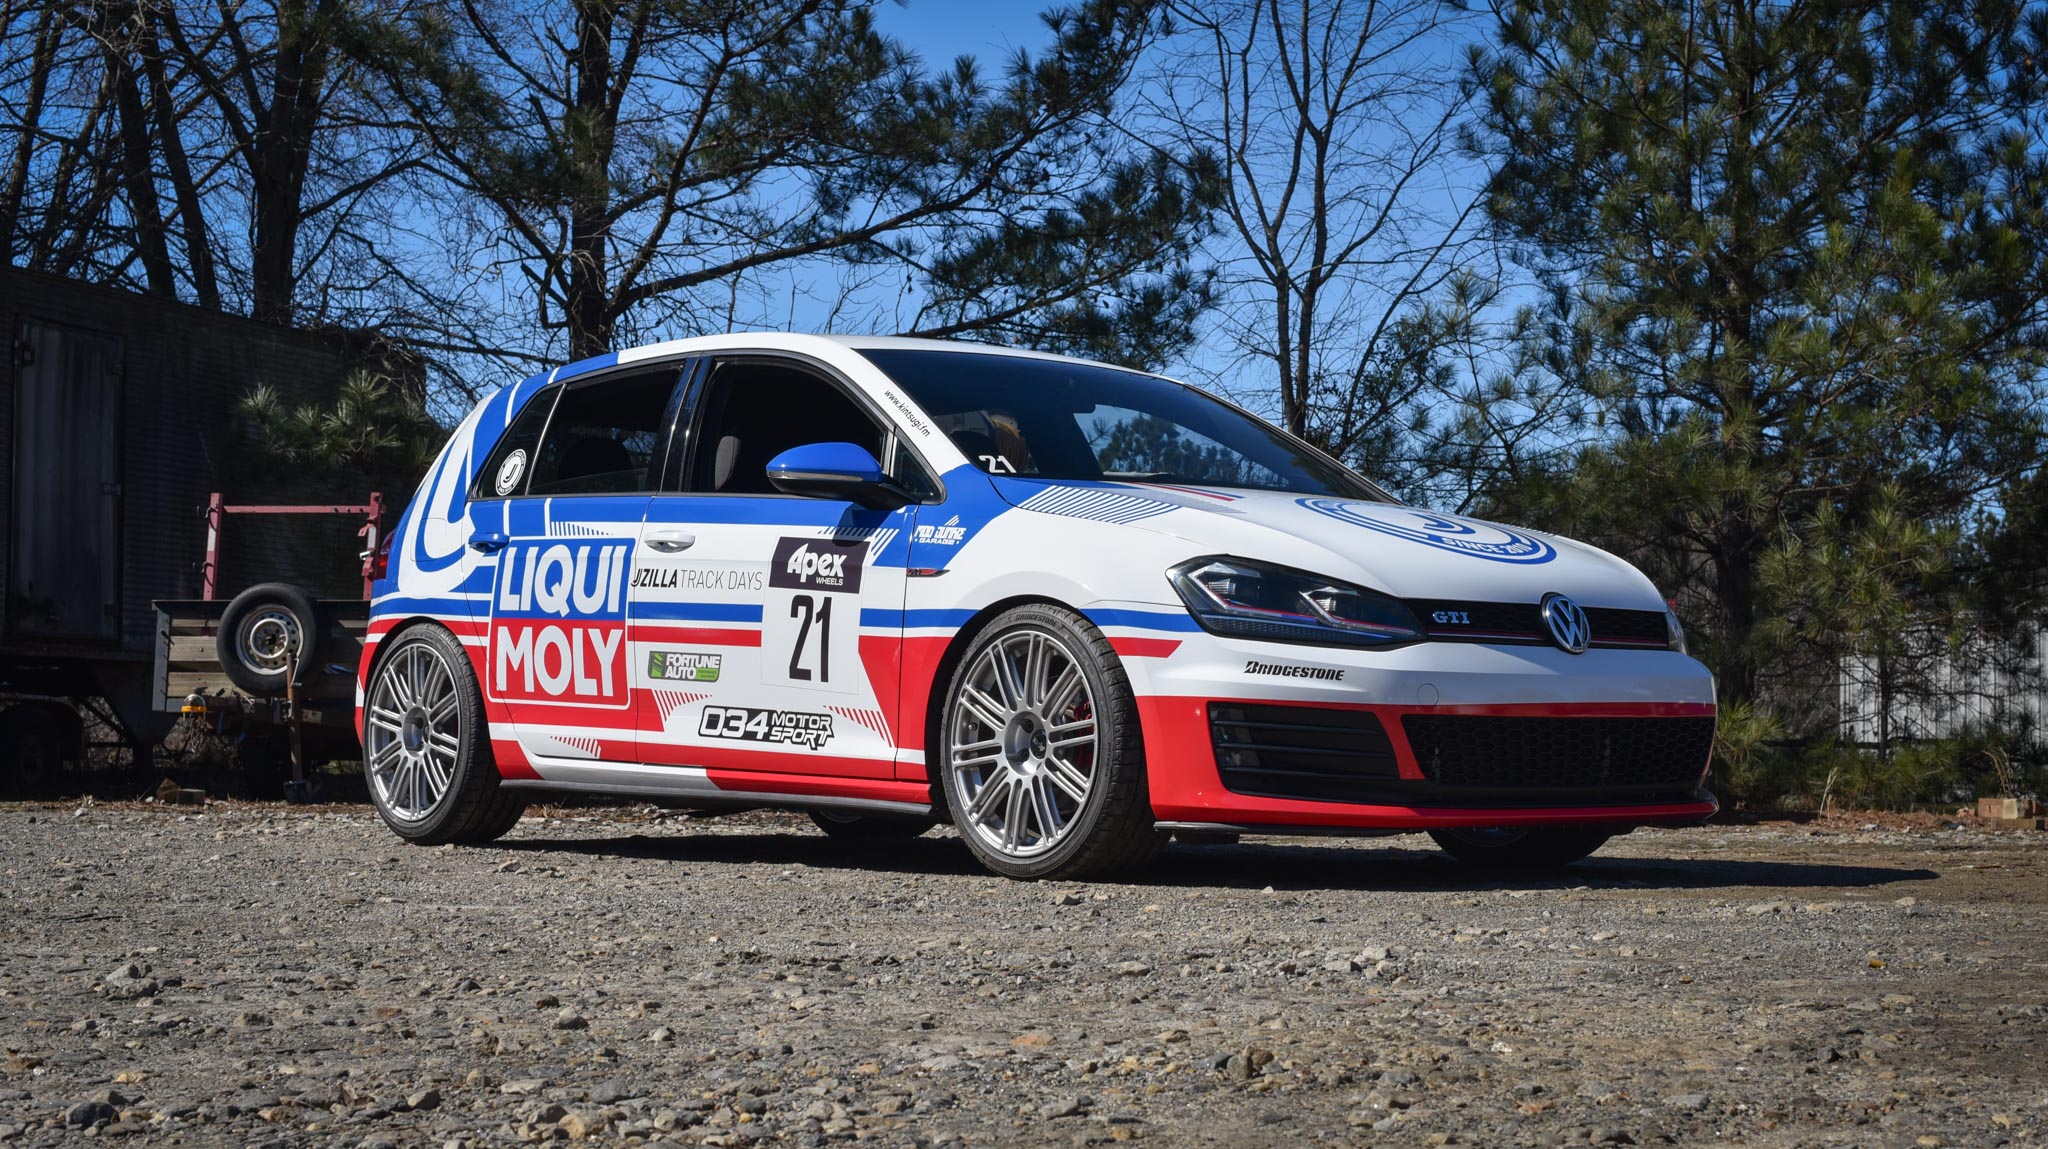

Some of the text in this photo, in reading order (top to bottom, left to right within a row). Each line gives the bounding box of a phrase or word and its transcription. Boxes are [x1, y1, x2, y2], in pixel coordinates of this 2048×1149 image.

[883, 389, 932, 437] www.kintsugi.fm
[978, 455, 1017, 474] 21
[918, 537, 956, 546] GARAGE
[1441, 537, 1505, 554] SINCE
[499, 544, 628, 618] LIQUI
[681, 569, 725, 590] TRACK
[727, 570, 763, 591] DAYS
[816, 577, 843, 586] WHEELS
[1432, 611, 1471, 625] GTI
[789, 594, 832, 683] 21
[496, 625, 624, 697] MOLY
[666, 653, 721, 669] FORTUNE
[1243, 660, 1345, 681] BRIDGESTONE
[664, 665, 697, 680] AUTO
[699, 706, 832, 740] 034 MOTOR
[769, 726, 828, 748] SPORT
